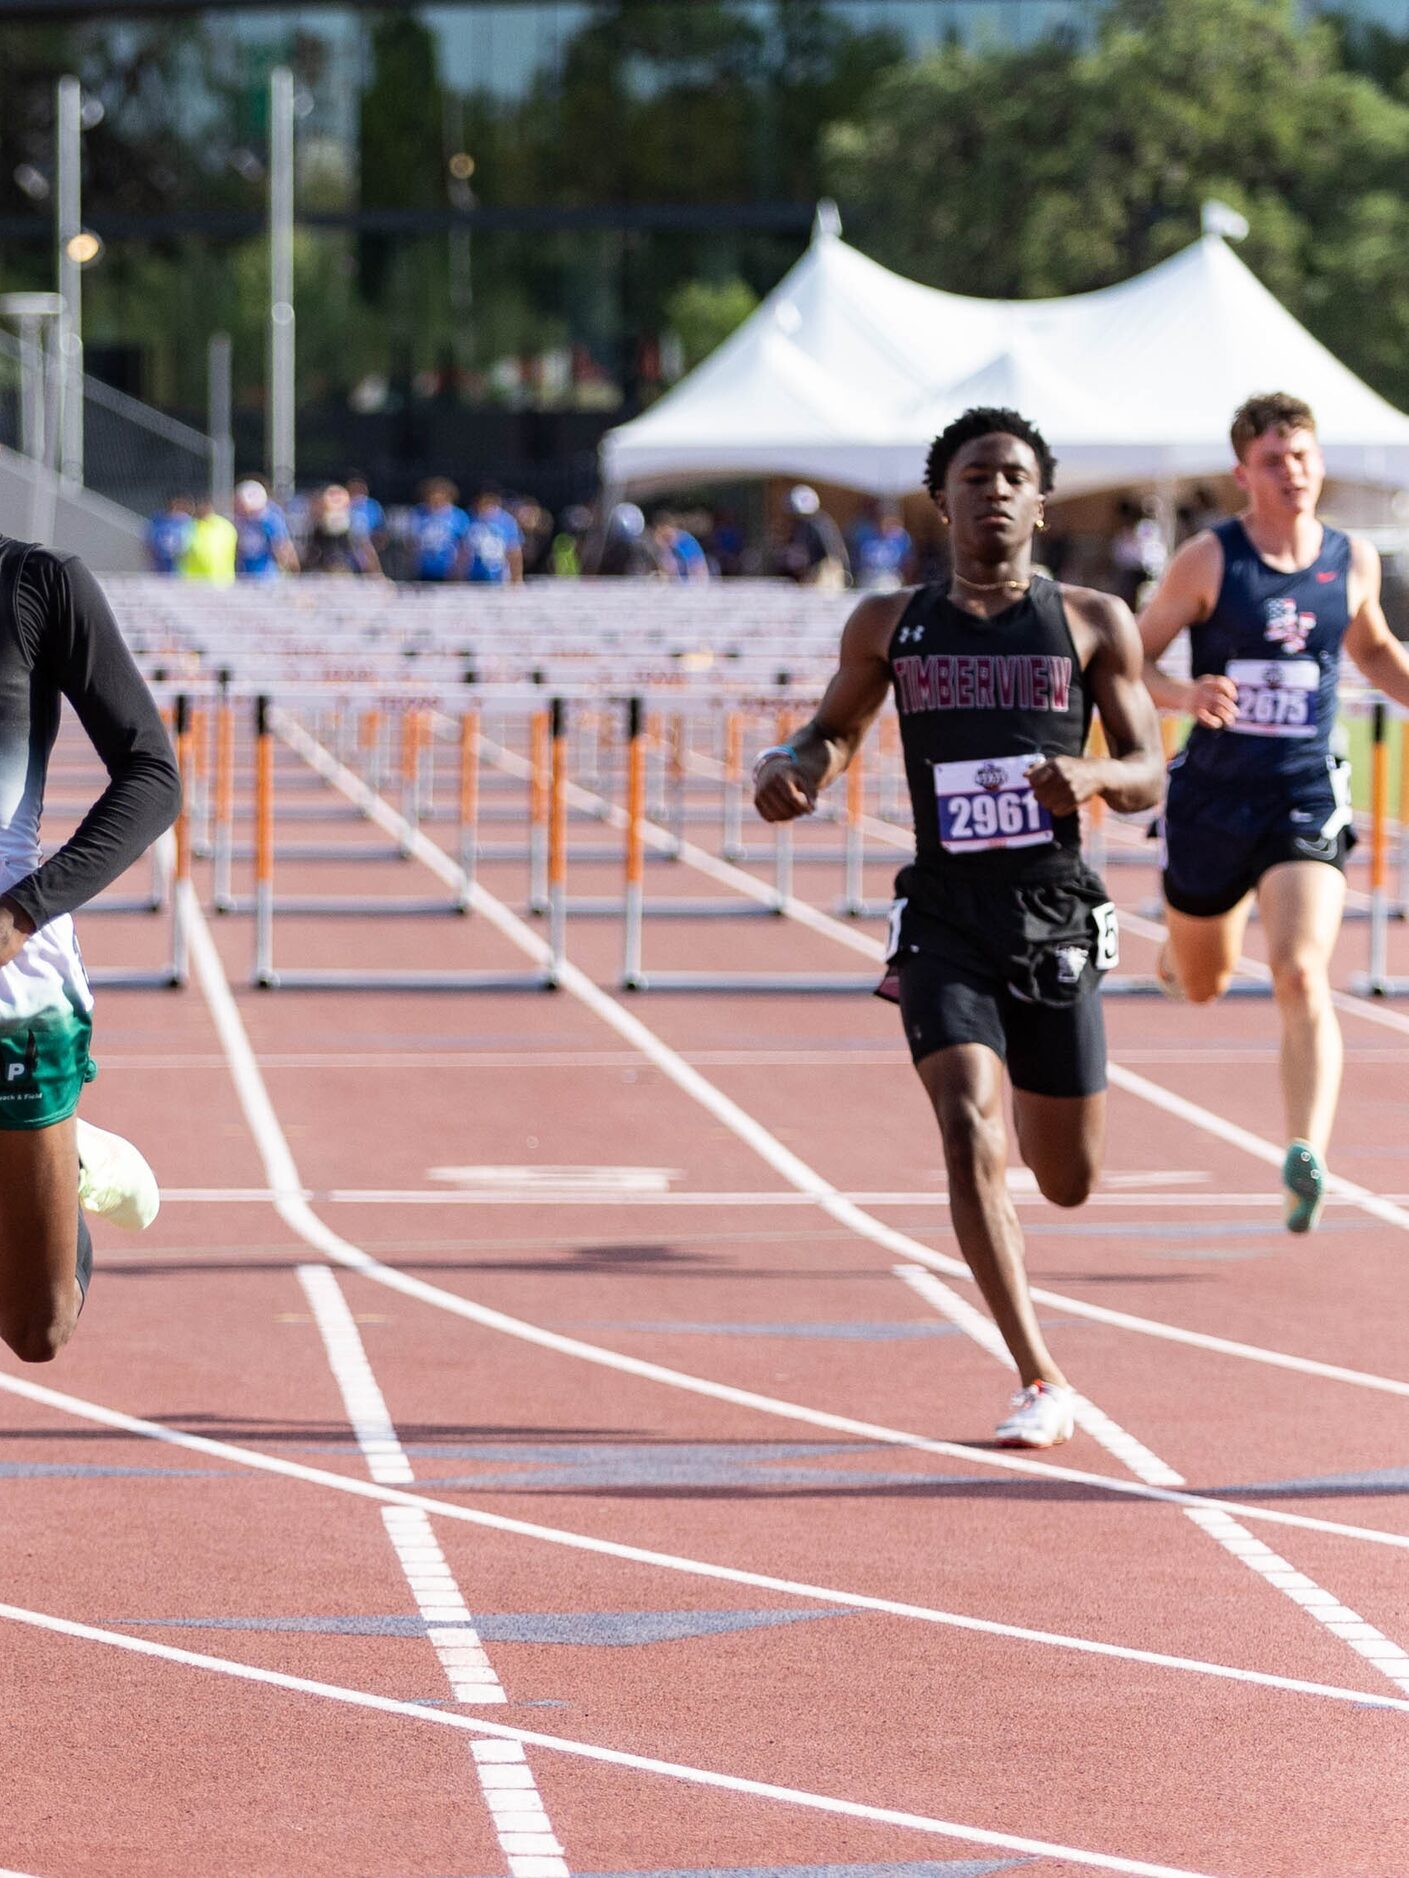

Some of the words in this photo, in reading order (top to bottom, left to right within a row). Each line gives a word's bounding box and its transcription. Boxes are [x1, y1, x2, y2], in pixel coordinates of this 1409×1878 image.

[893, 655, 1072, 715] TIMBERVIEW
[948, 792, 1040, 838] 2961
[7, 1062, 25, 1081] P
